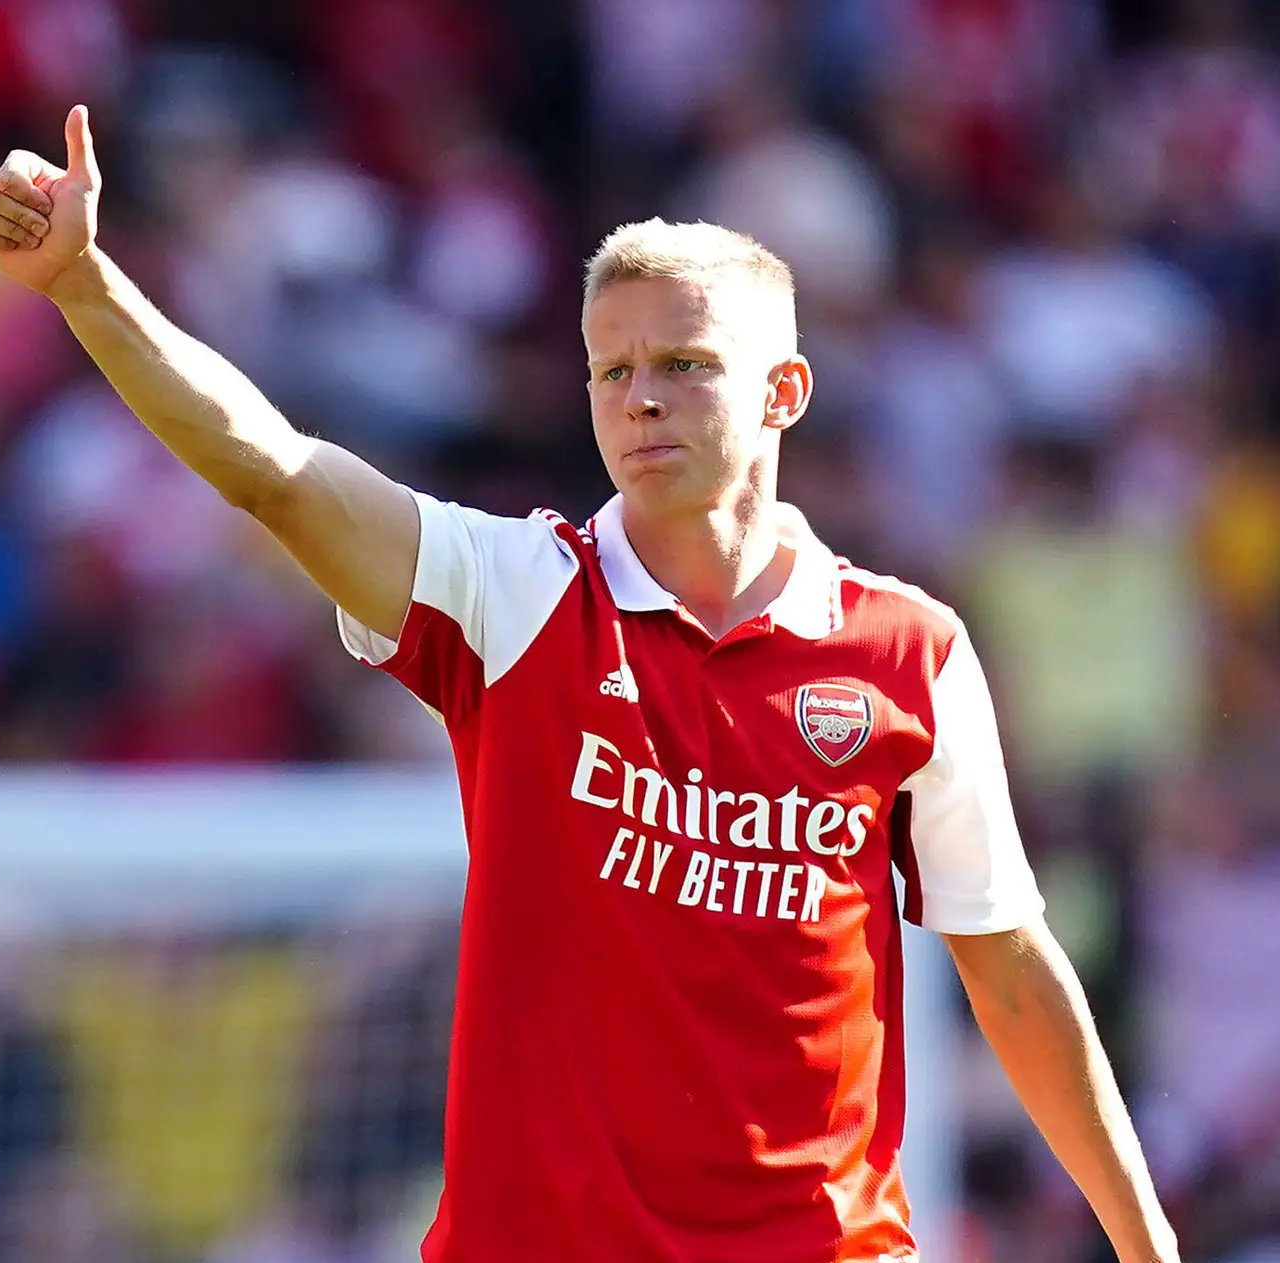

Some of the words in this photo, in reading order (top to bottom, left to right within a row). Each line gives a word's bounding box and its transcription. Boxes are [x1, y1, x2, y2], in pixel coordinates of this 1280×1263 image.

[570, 730, 873, 857] Emirates
[599, 827, 673, 895] FLY
[677, 850, 826, 923] BETTER
